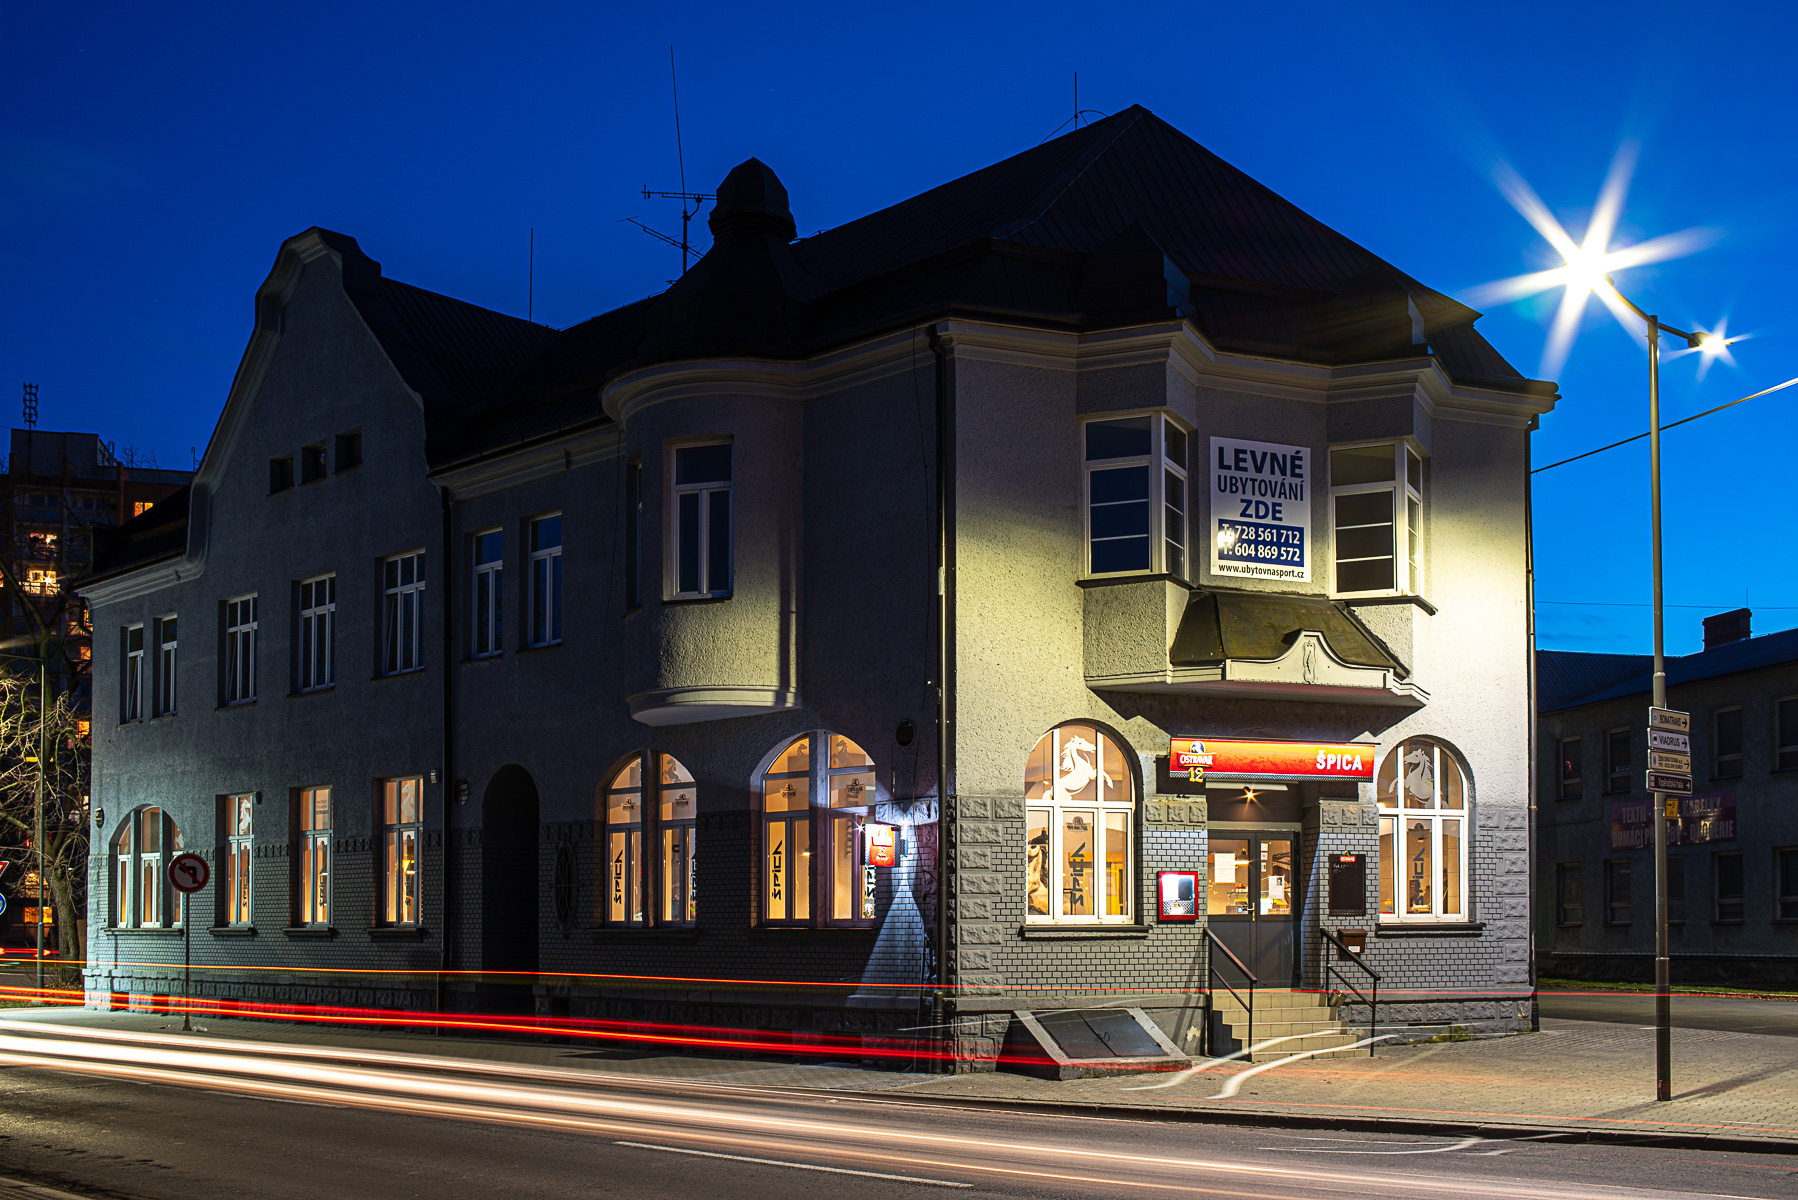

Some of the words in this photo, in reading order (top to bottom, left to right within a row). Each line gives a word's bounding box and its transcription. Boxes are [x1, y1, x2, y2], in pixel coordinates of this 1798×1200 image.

[1218, 446, 1304, 479] LEVNÉ
[1218, 474, 1305, 501] UBYTOVÁNÍ
[1239, 498, 1283, 522] ZDE
[1235, 525, 1256, 540] 728
[1257, 528, 1277, 542] 561
[1280, 530, 1300, 545] 712
[1234, 543, 1256, 557] 604
[1257, 544, 1278, 559] 869
[1280, 547, 1300, 562] 572
[1218, 564, 1304, 579] www.ubytovnasport.cz
[1659, 714, 1682, 727] BONATRANS
[1658, 735, 1681, 747] VIADRUS
[1180, 754, 1213, 765] OSTRAVAR
[1316, 750, 1363, 771] ŠPICA
[1188, 767, 1204, 783] 12
[1622, 806, 1648, 824] TEXTIL
[1612, 824, 1644, 847] DOMÁCÍ
